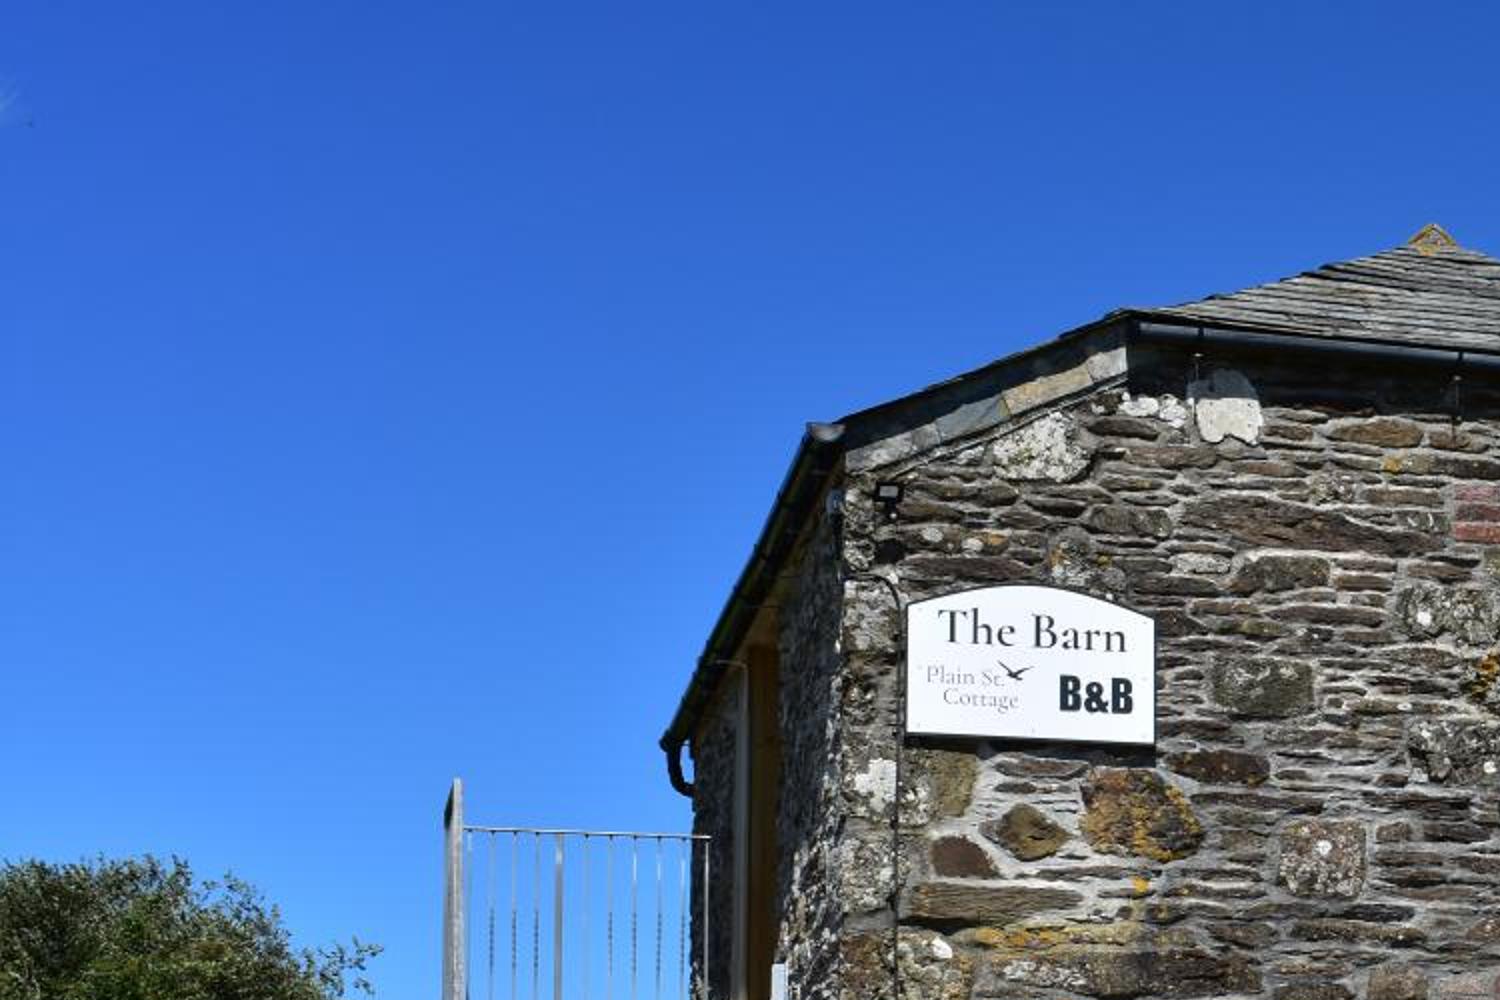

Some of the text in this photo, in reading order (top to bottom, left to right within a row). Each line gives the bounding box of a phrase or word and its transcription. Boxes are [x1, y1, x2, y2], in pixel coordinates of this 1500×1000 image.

[938, 607, 1128, 653] The Barn
[926, 664, 976, 685] Plain
[943, 687, 1019, 714] Cottage
[1059, 674, 1133, 715] B&B
